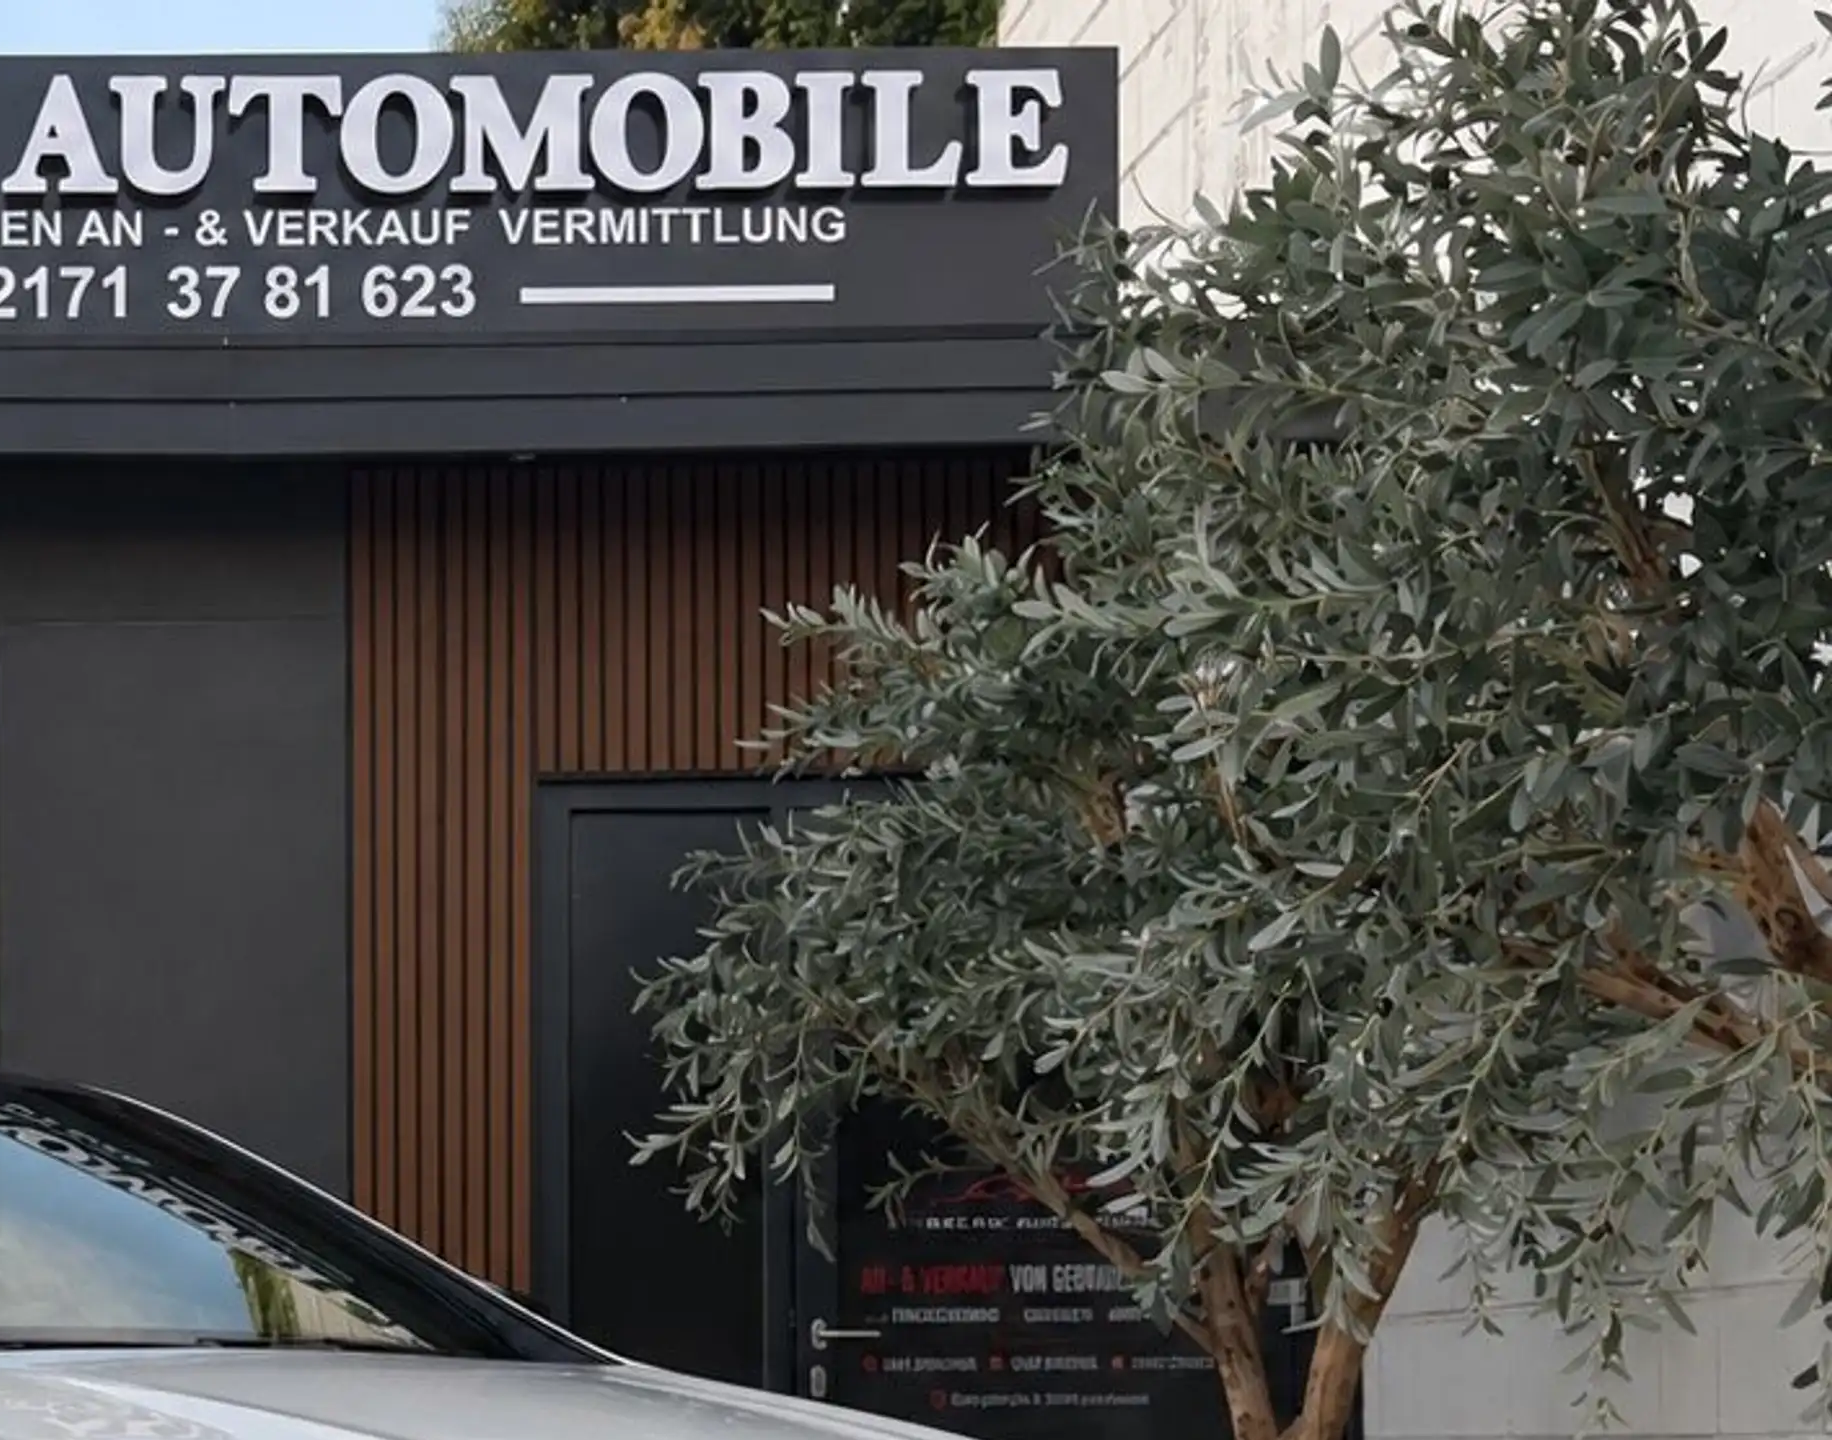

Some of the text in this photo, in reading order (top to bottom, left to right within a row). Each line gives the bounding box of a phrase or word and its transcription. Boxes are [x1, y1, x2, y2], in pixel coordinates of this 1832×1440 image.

[1, 69, 1069, 194] AUTOMOBILE
[77, 209, 142, 246] AN
[195, 209, 228, 246] &
[243, 209, 471, 246] VERKAUF
[498, 206, 846, 245] VERMITTLUNG
[167, 265, 241, 319] 37
[264, 265, 329, 318] 81
[362, 264, 476, 318] 623
